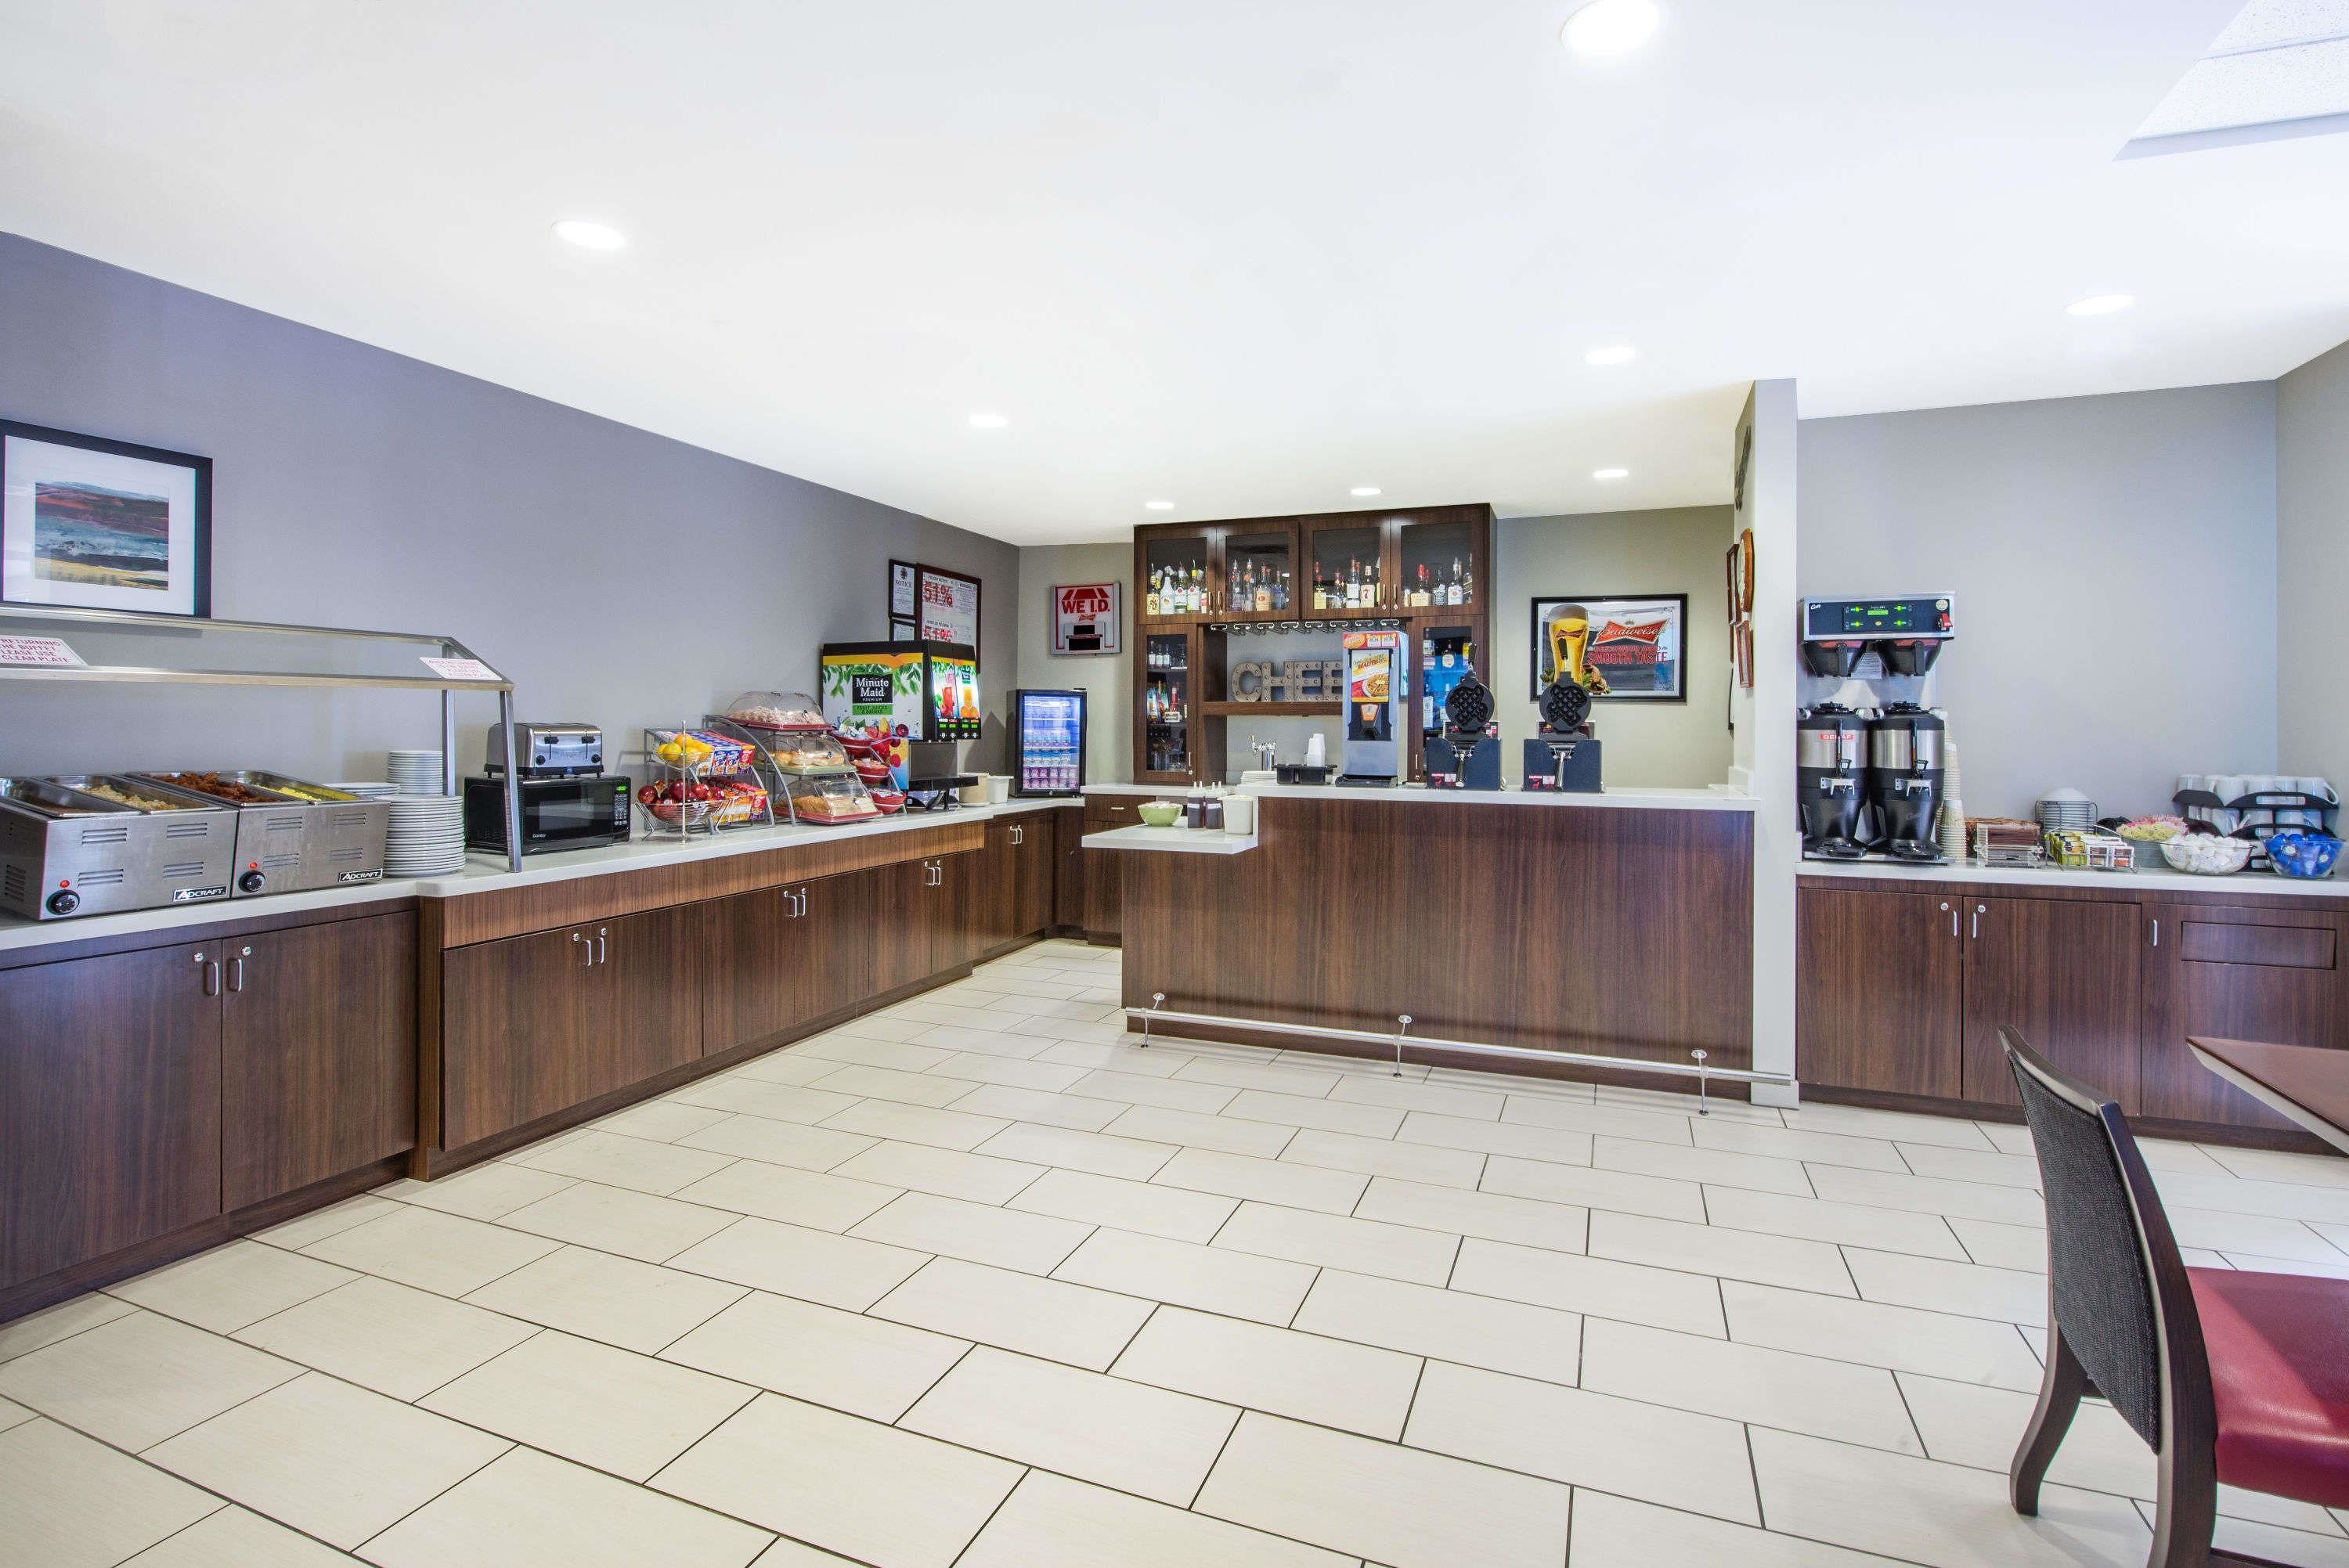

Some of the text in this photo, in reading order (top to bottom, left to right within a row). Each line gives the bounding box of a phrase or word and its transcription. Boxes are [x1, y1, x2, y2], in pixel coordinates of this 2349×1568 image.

[922, 581, 953, 607] 51%
[1062, 600, 1110, 615] WE I.D.
[1597, 625, 1666, 636] Budweiser
[1587, 651, 1668, 665] SMOOTH TASTE
[856, 677, 889, 687] Minute
[860, 687, 885, 697] Maid
[340, 871, 381, 881] ADCRAFT
[176, 889, 226, 899] ADCRAFT
